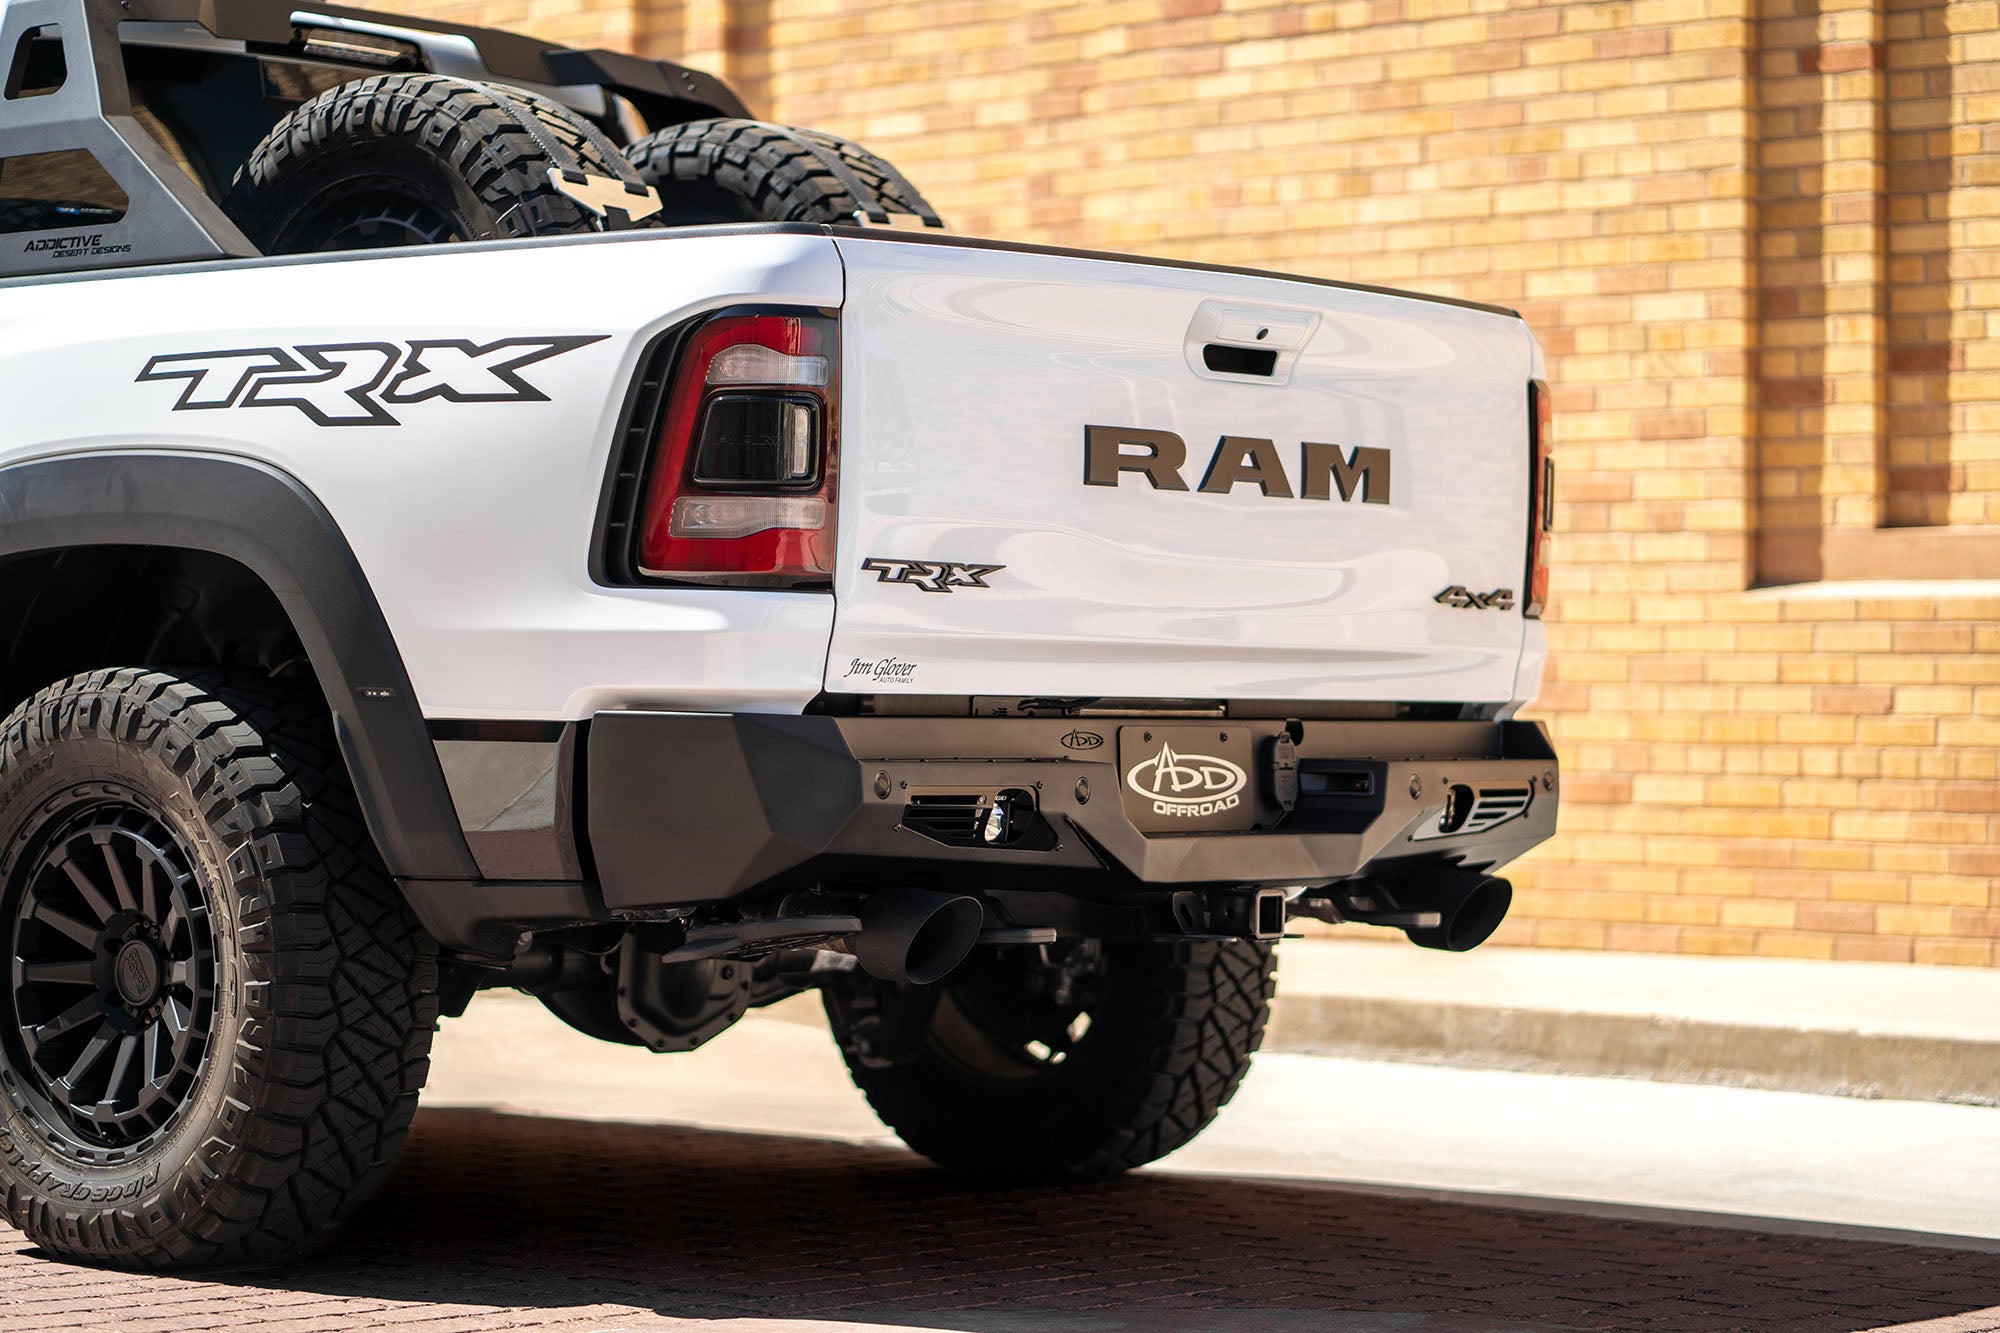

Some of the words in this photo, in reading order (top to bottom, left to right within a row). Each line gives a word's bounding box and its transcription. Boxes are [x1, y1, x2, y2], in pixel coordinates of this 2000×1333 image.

[24, 235, 102, 252] ADDICTIVE
[52, 248, 89, 259] DESERT
[91, 244, 132, 255] DESIGNS
[135, 335, 612, 427] TRX
[1083, 424, 1391, 505] RAM
[861, 557, 1007, 593] TRX
[1433, 585, 1515, 610] 4x4
[843, 658, 873, 678] Jim
[872, 657, 917, 681] Glover
[1153, 741, 1236, 792] ADD
[1153, 794, 1240, 817] OFFROAD
[91, 1162, 160, 1202] RIDGE
